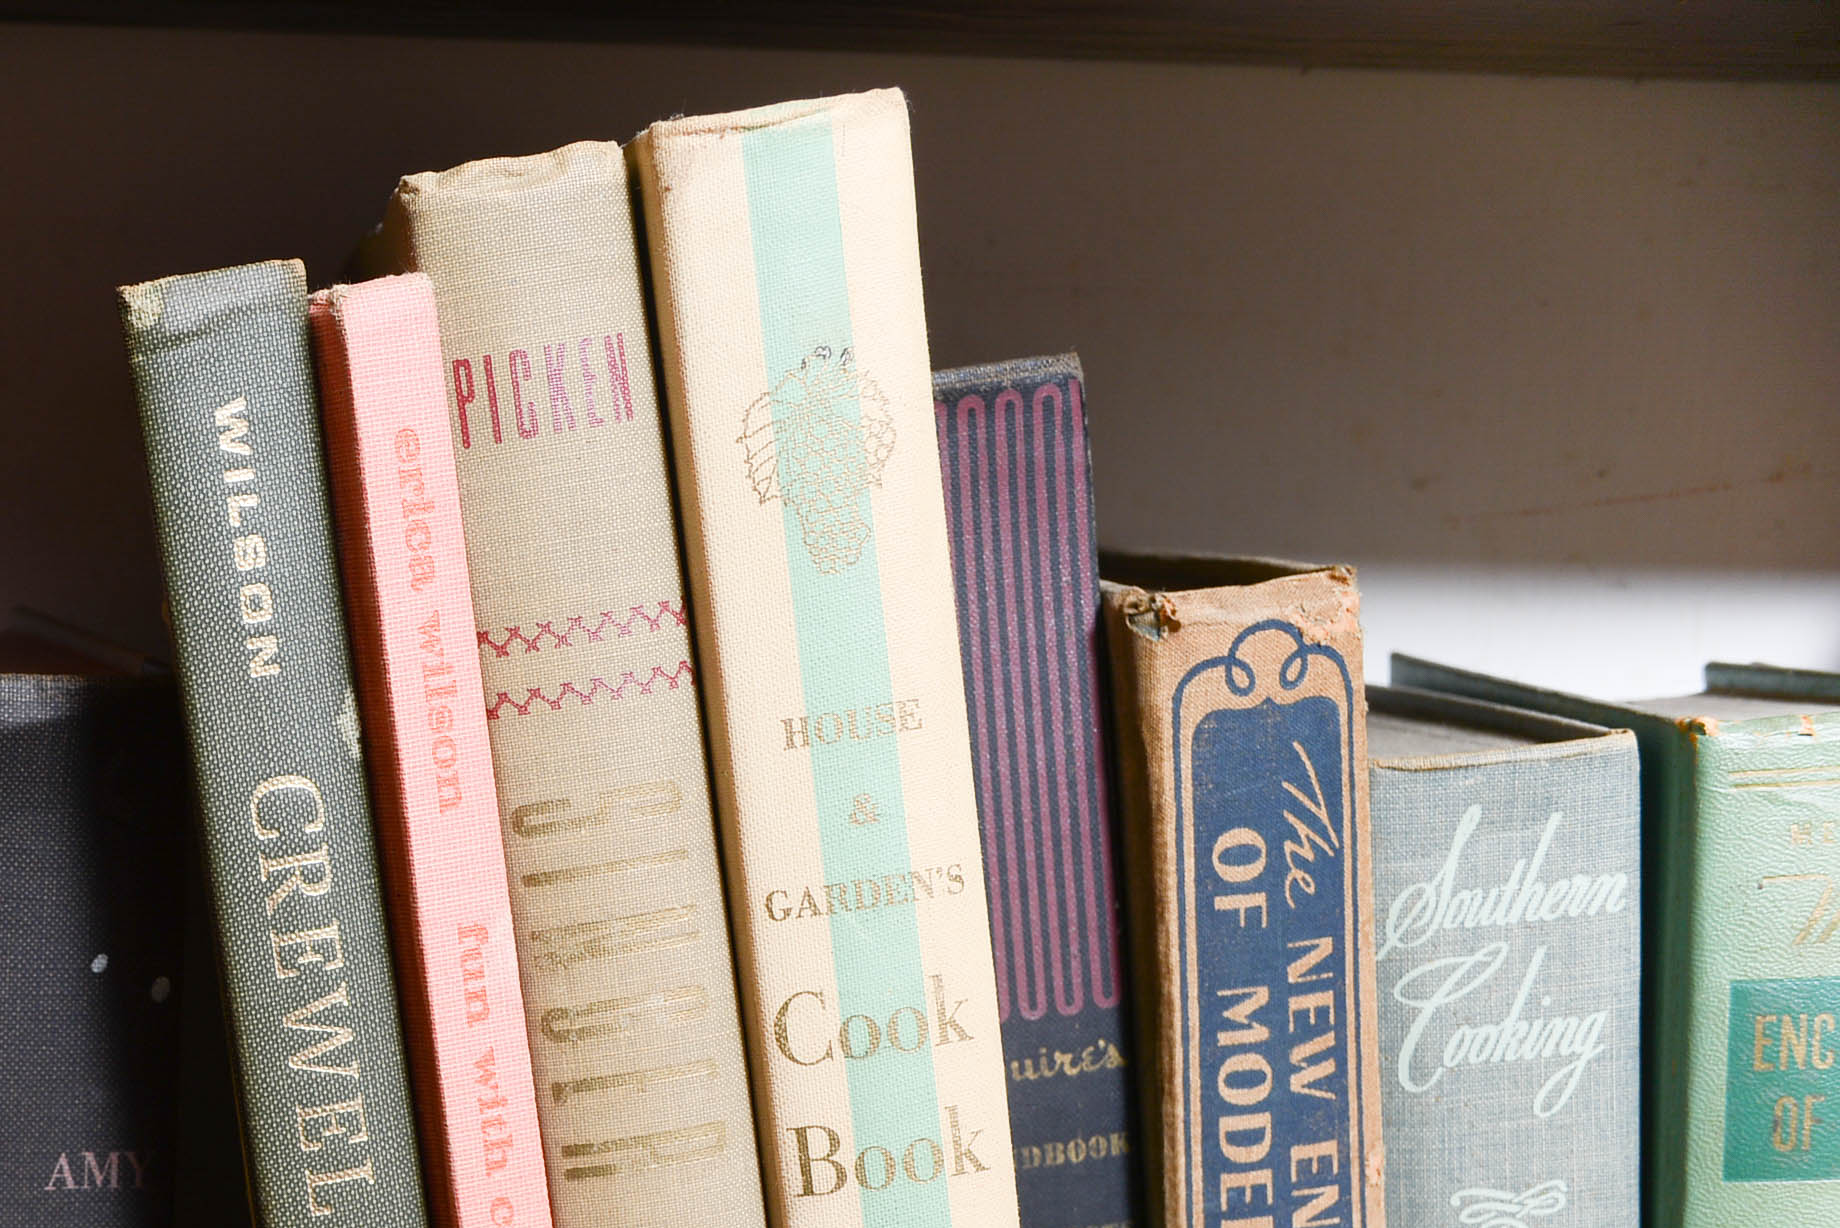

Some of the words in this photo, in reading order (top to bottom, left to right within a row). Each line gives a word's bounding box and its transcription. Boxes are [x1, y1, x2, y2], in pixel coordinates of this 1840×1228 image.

[452, 332, 634, 449] PICKEN
[214, 396, 281, 678] WILSON
[394, 427, 435, 592] erica
[419, 609, 462, 814] wilson
[780, 699, 923, 751] HOUSE
[849, 793, 881, 826] &
[1281, 740, 1340, 909] The
[764, 863, 966, 922] GARDEN'S
[1211, 826, 1269, 929] OF
[1376, 804, 1629, 961] Southern
[250, 774, 375, 1217] CREWEL
[457, 921, 493, 1029] fun
[773, 974, 975, 1067] Cook
[1287, 936, 1337, 1102] NEW
[1393, 941, 1608, 1119] Cooking
[473, 1045, 513, 1177] with
[786, 1105, 991, 1198] Book
[1773, 1096, 1825, 1152] OF
[44, 1151, 152, 1191] AMY
